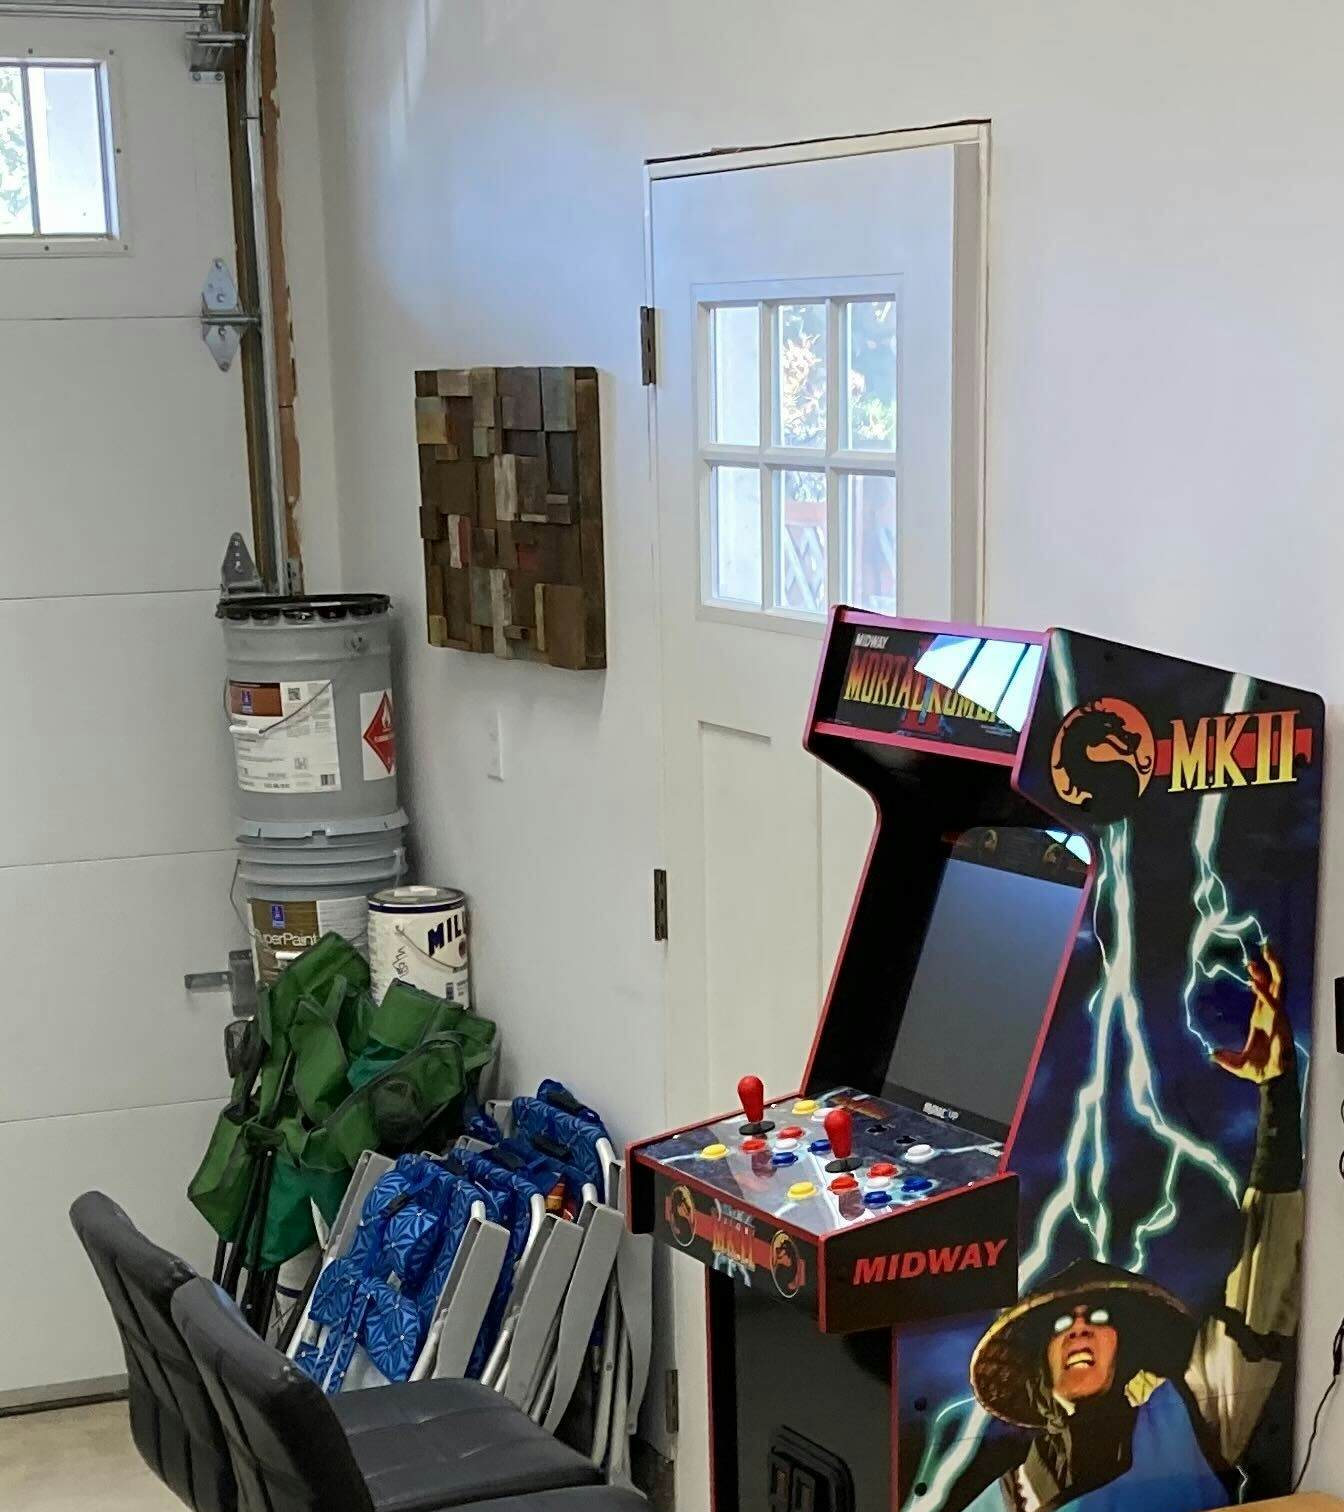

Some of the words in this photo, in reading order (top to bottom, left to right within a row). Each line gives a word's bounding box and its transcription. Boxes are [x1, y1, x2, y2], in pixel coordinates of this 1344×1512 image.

[855, 633, 888, 649] MIDWAY
[843, 652, 927, 709] MORTAL
[428, 912, 466, 957] MIL
[852, 1238, 1008, 1286] MIDWAY
